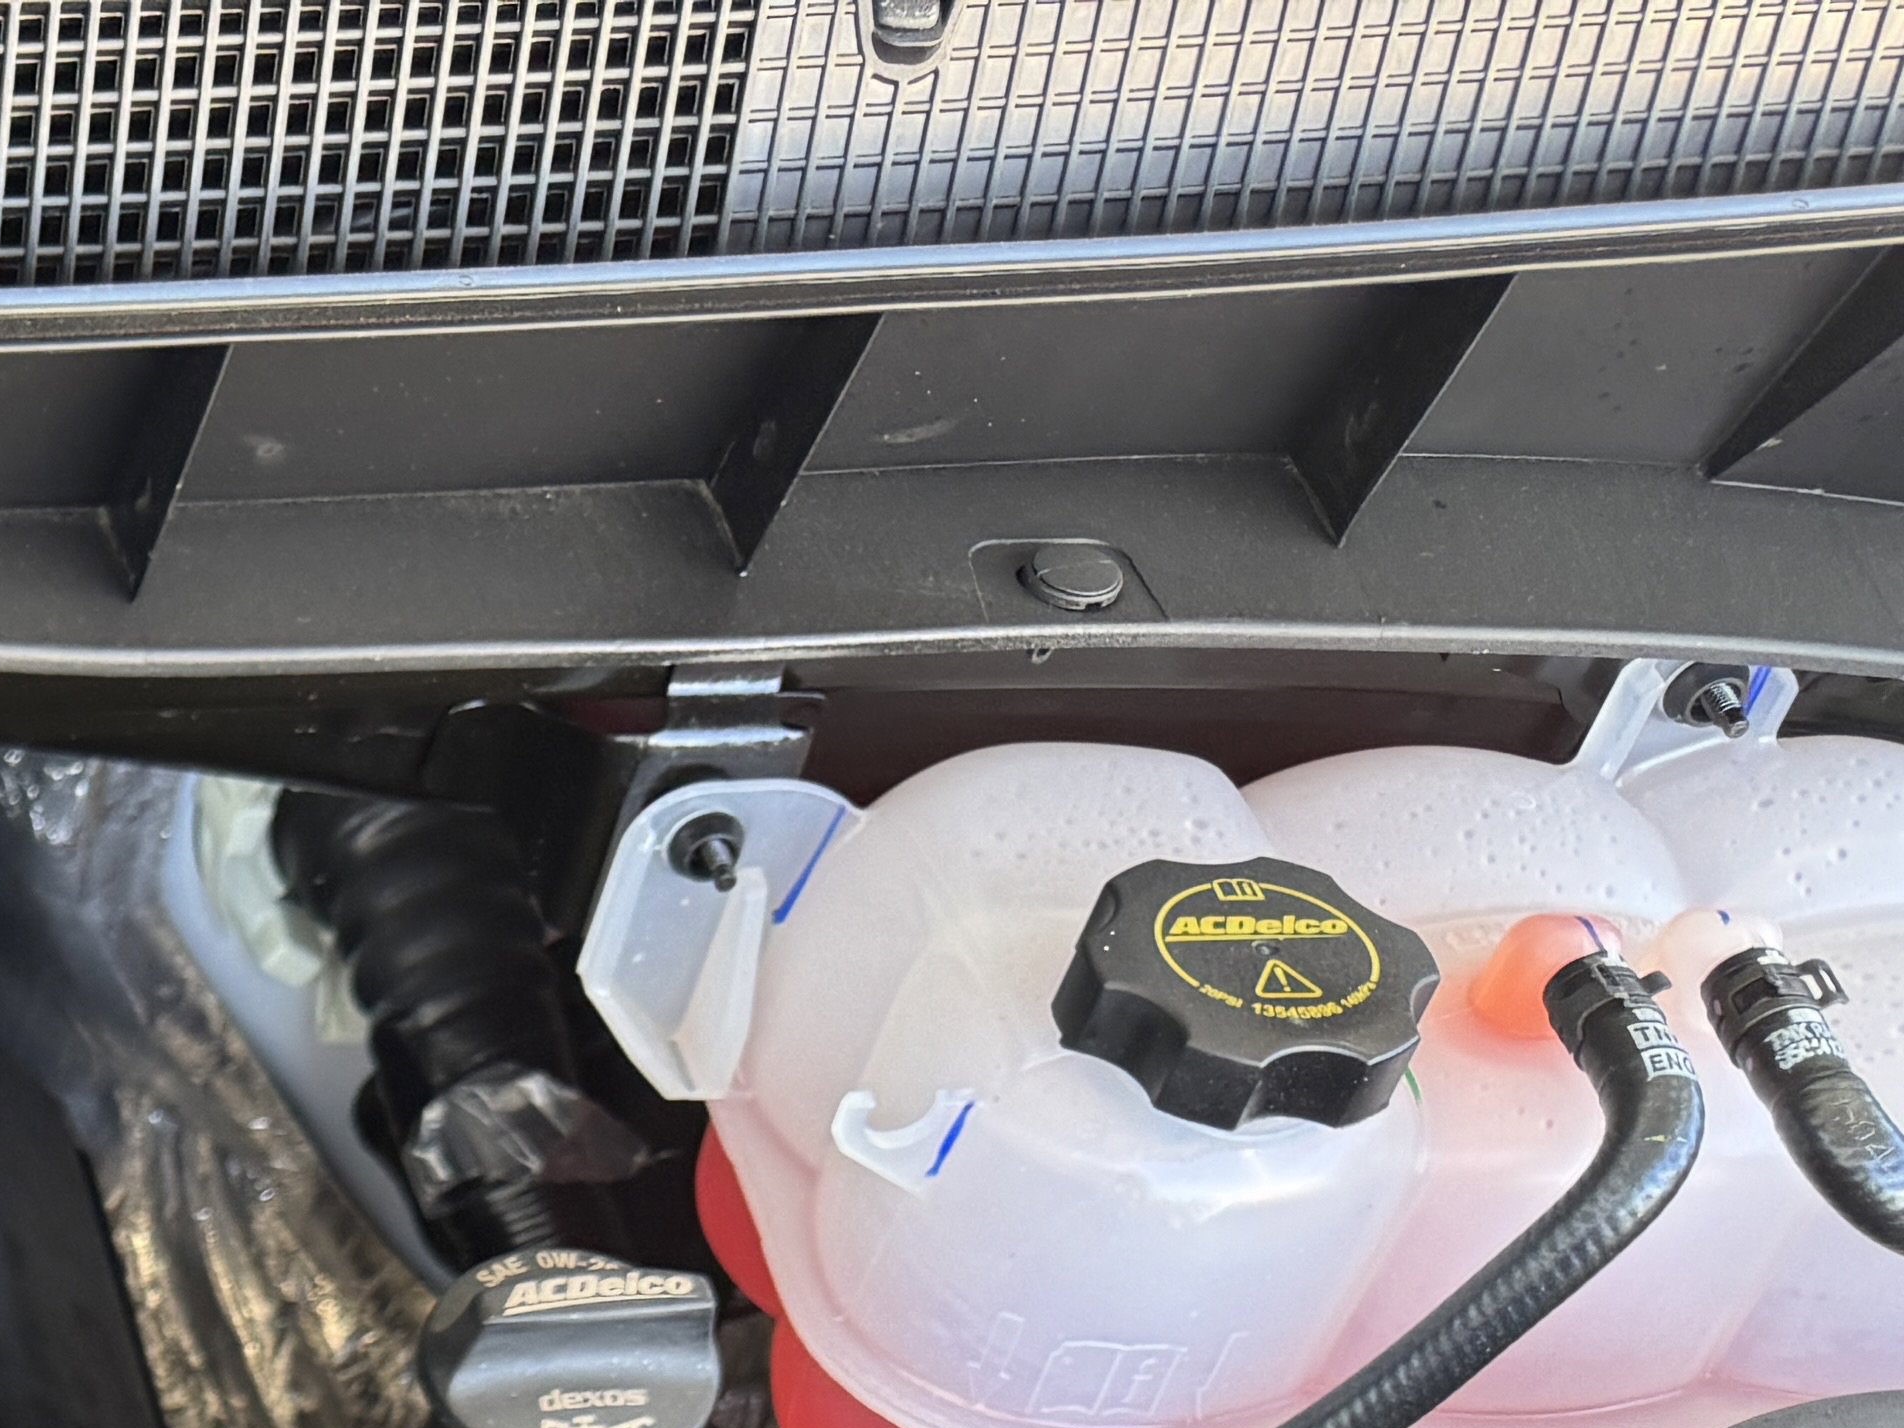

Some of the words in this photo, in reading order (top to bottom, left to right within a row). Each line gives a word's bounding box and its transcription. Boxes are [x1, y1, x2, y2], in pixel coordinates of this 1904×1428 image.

[1169, 914, 1347, 935] ACDelco
[475, 1255, 529, 1289] SAE
[505, 1271, 694, 1307] ACDelco
[538, 1388, 649, 1412] dexos
